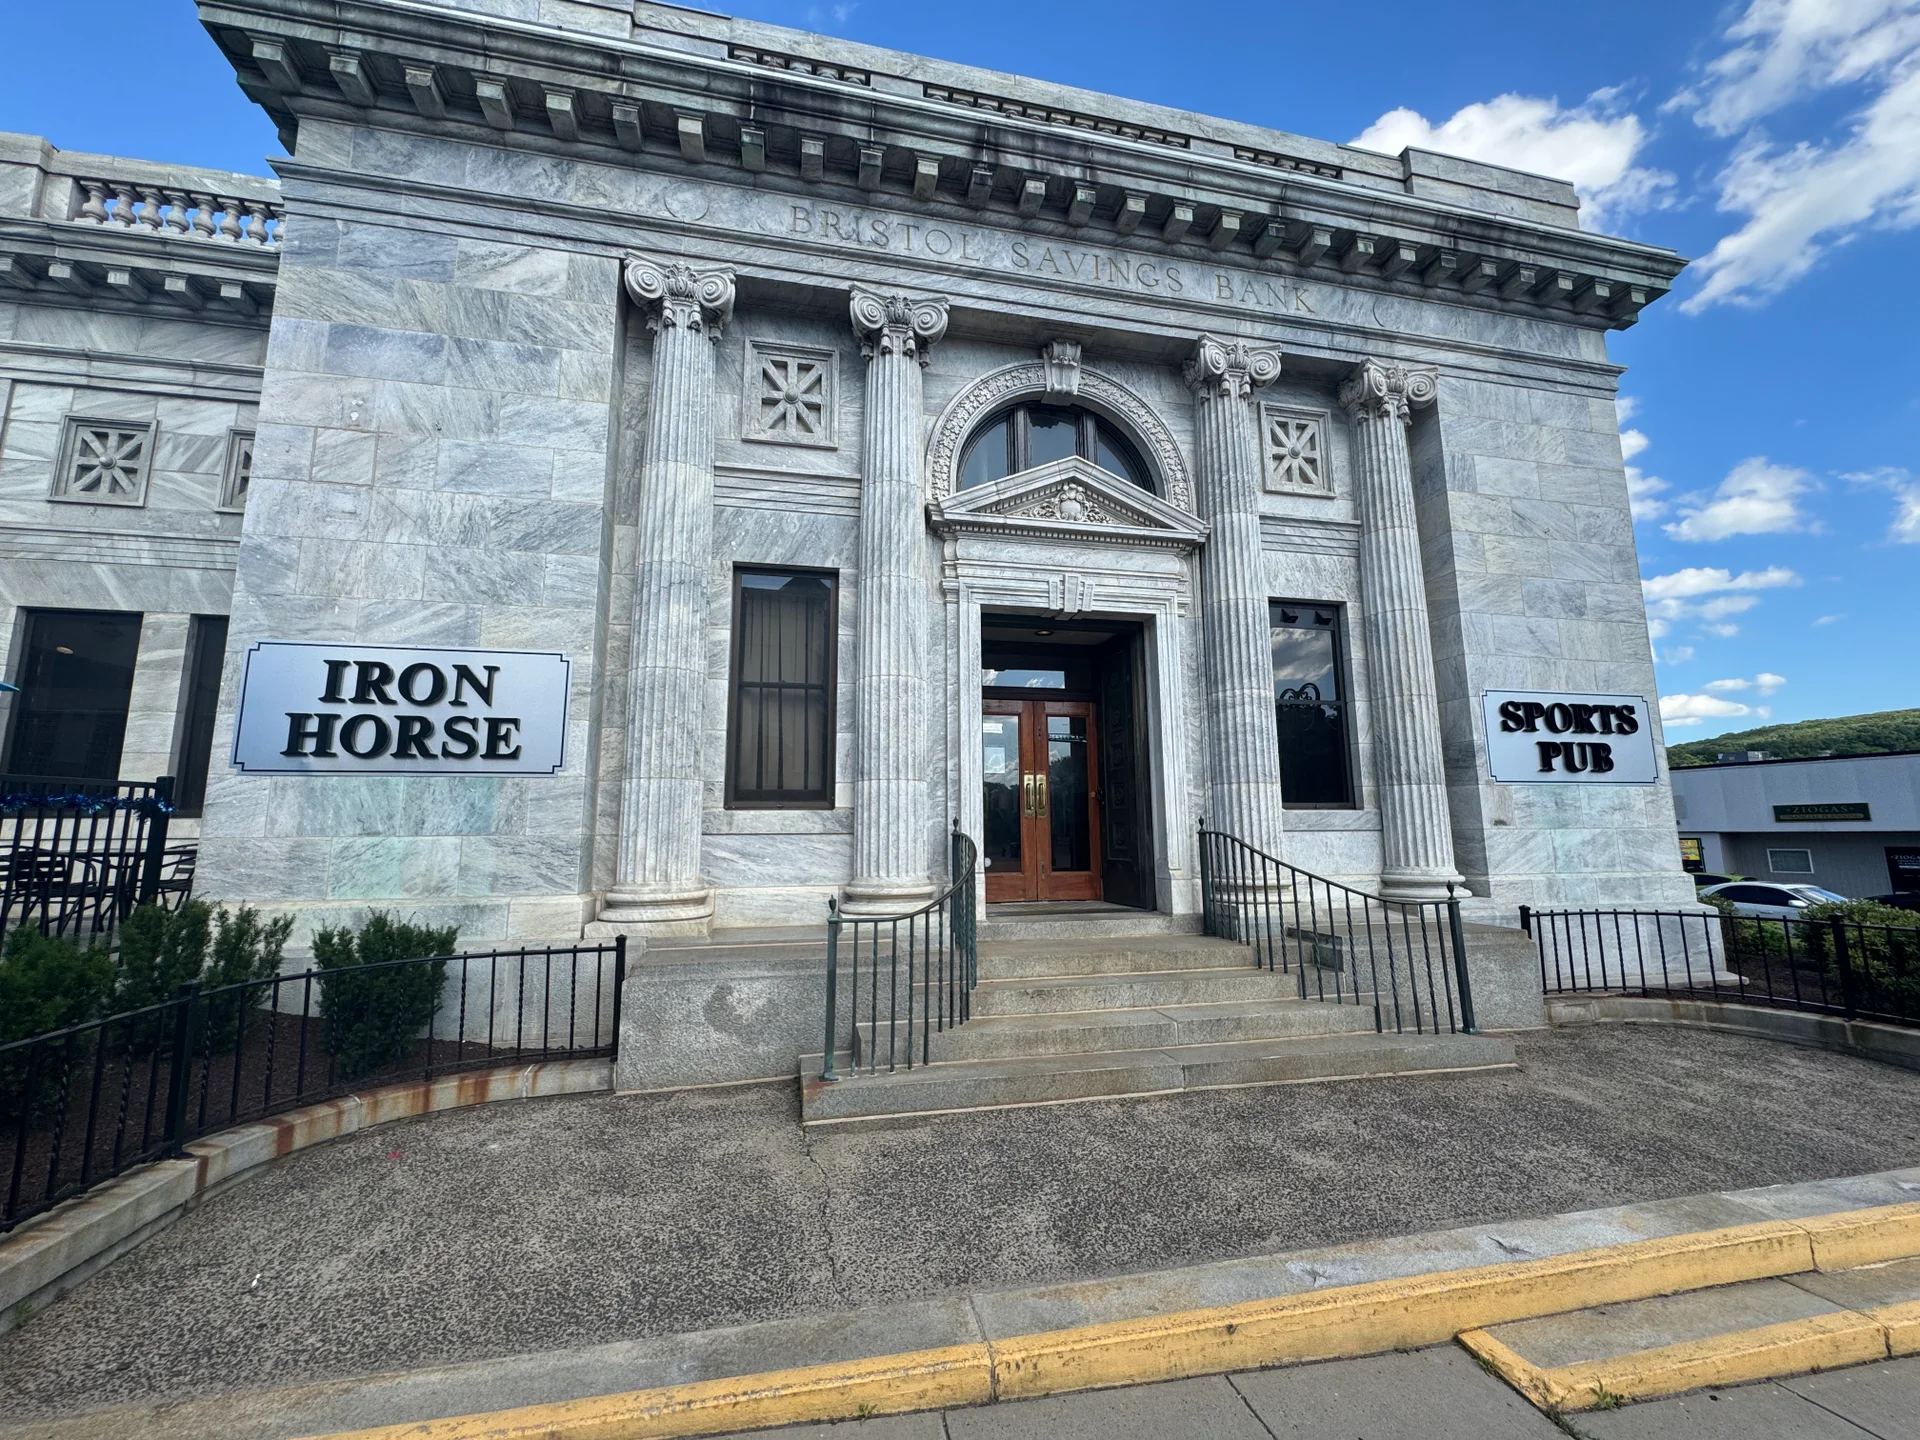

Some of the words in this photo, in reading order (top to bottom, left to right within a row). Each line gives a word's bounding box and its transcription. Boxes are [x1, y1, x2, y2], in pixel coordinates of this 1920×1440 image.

[790, 205, 981, 262] BRISTOL
[1011, 242, 1184, 292] SAVINGS
[1215, 273, 1316, 313] BANK
[318, 659, 500, 707] IRON
[279, 712, 521, 760] HORSE
[1499, 700, 1639, 735] SPORTS
[1535, 741, 1614, 773] PUB
